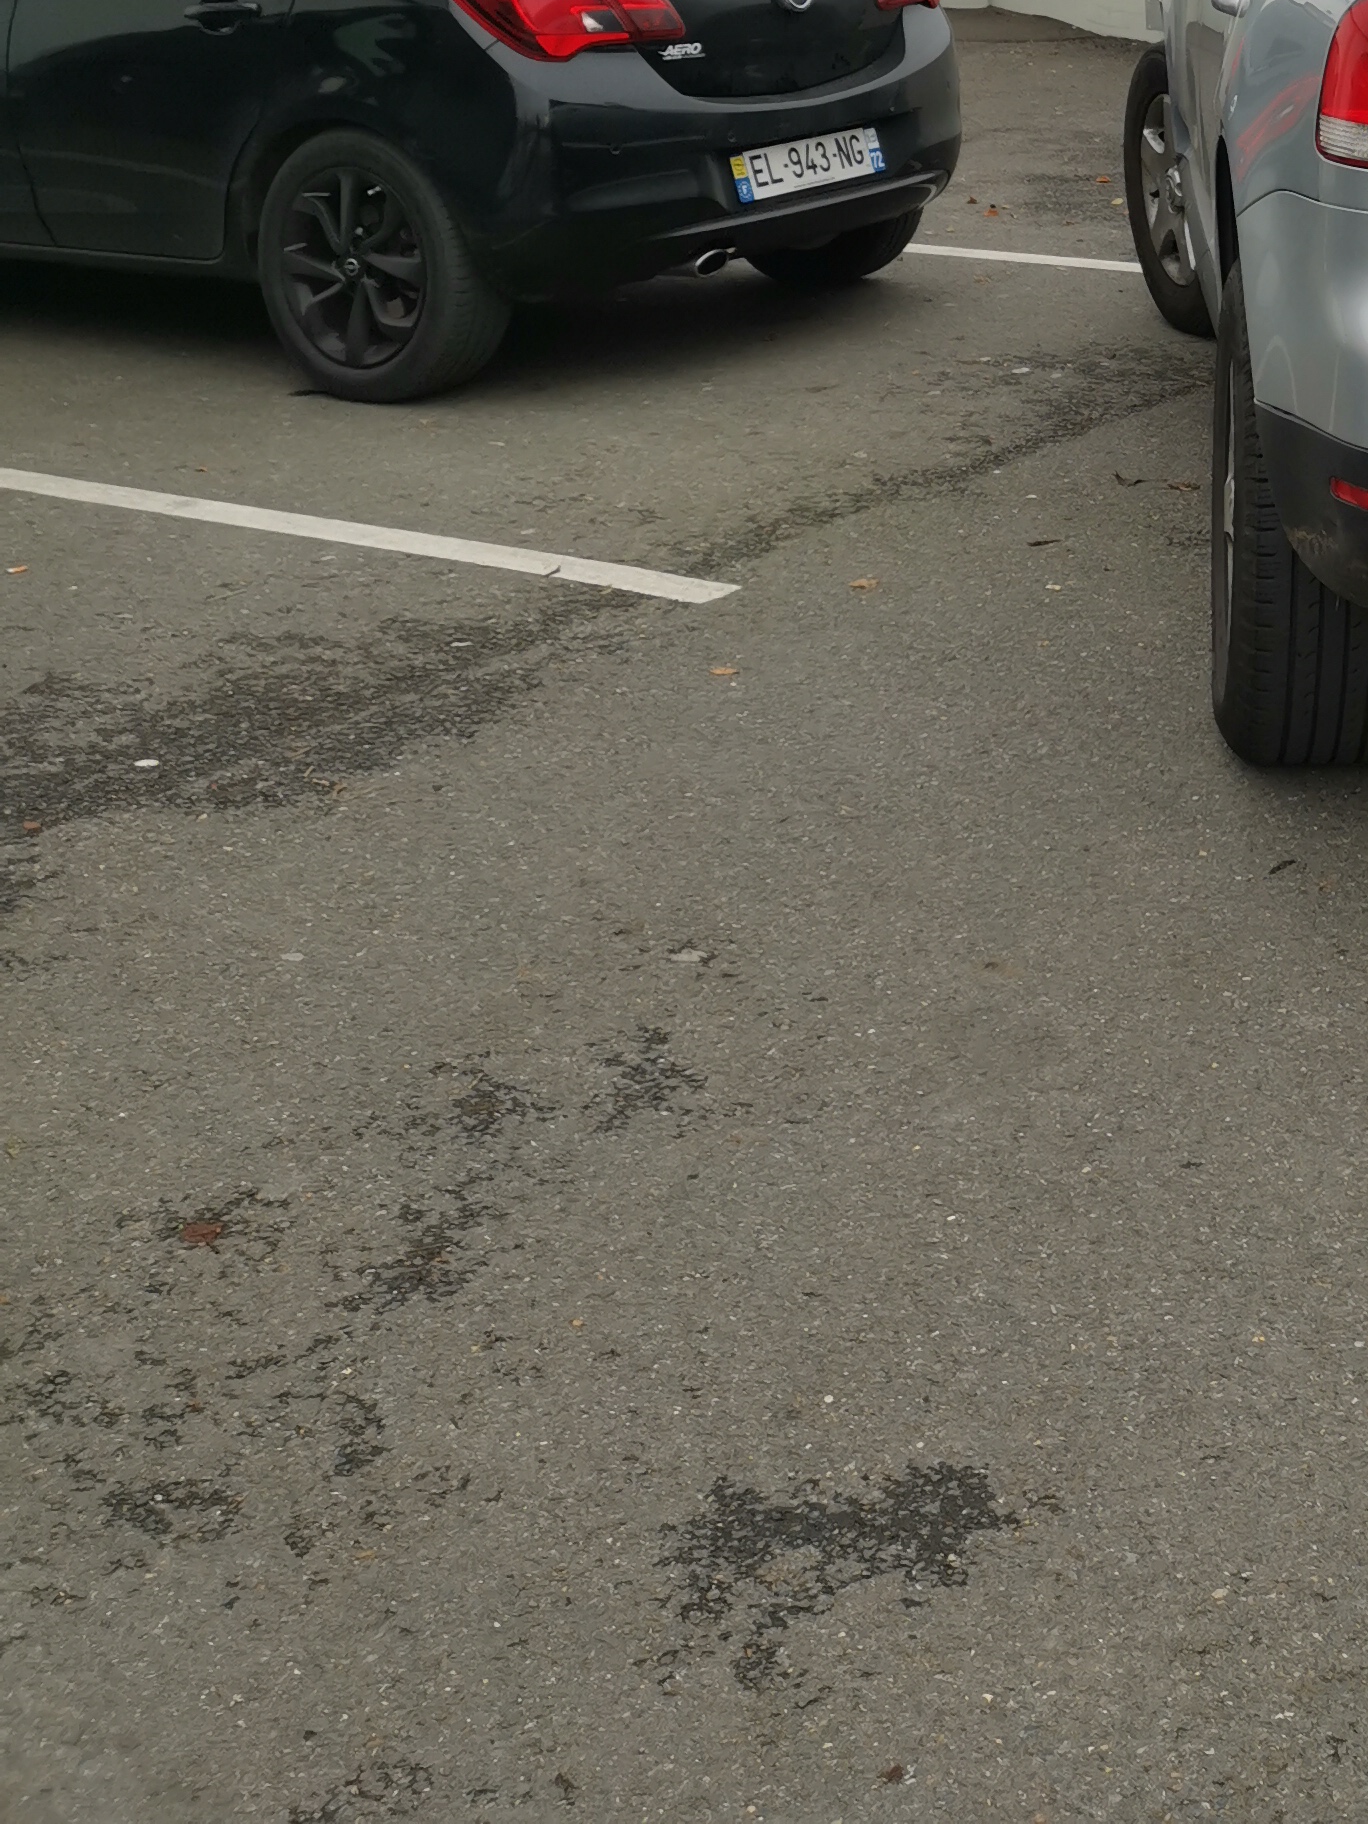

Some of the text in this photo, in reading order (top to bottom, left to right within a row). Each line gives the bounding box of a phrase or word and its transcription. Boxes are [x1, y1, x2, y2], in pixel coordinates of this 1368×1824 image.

[657, 42, 702, 56] AERO
[749, 134, 865, 188] EL-943-NG
[869, 151, 886, 169] 72
